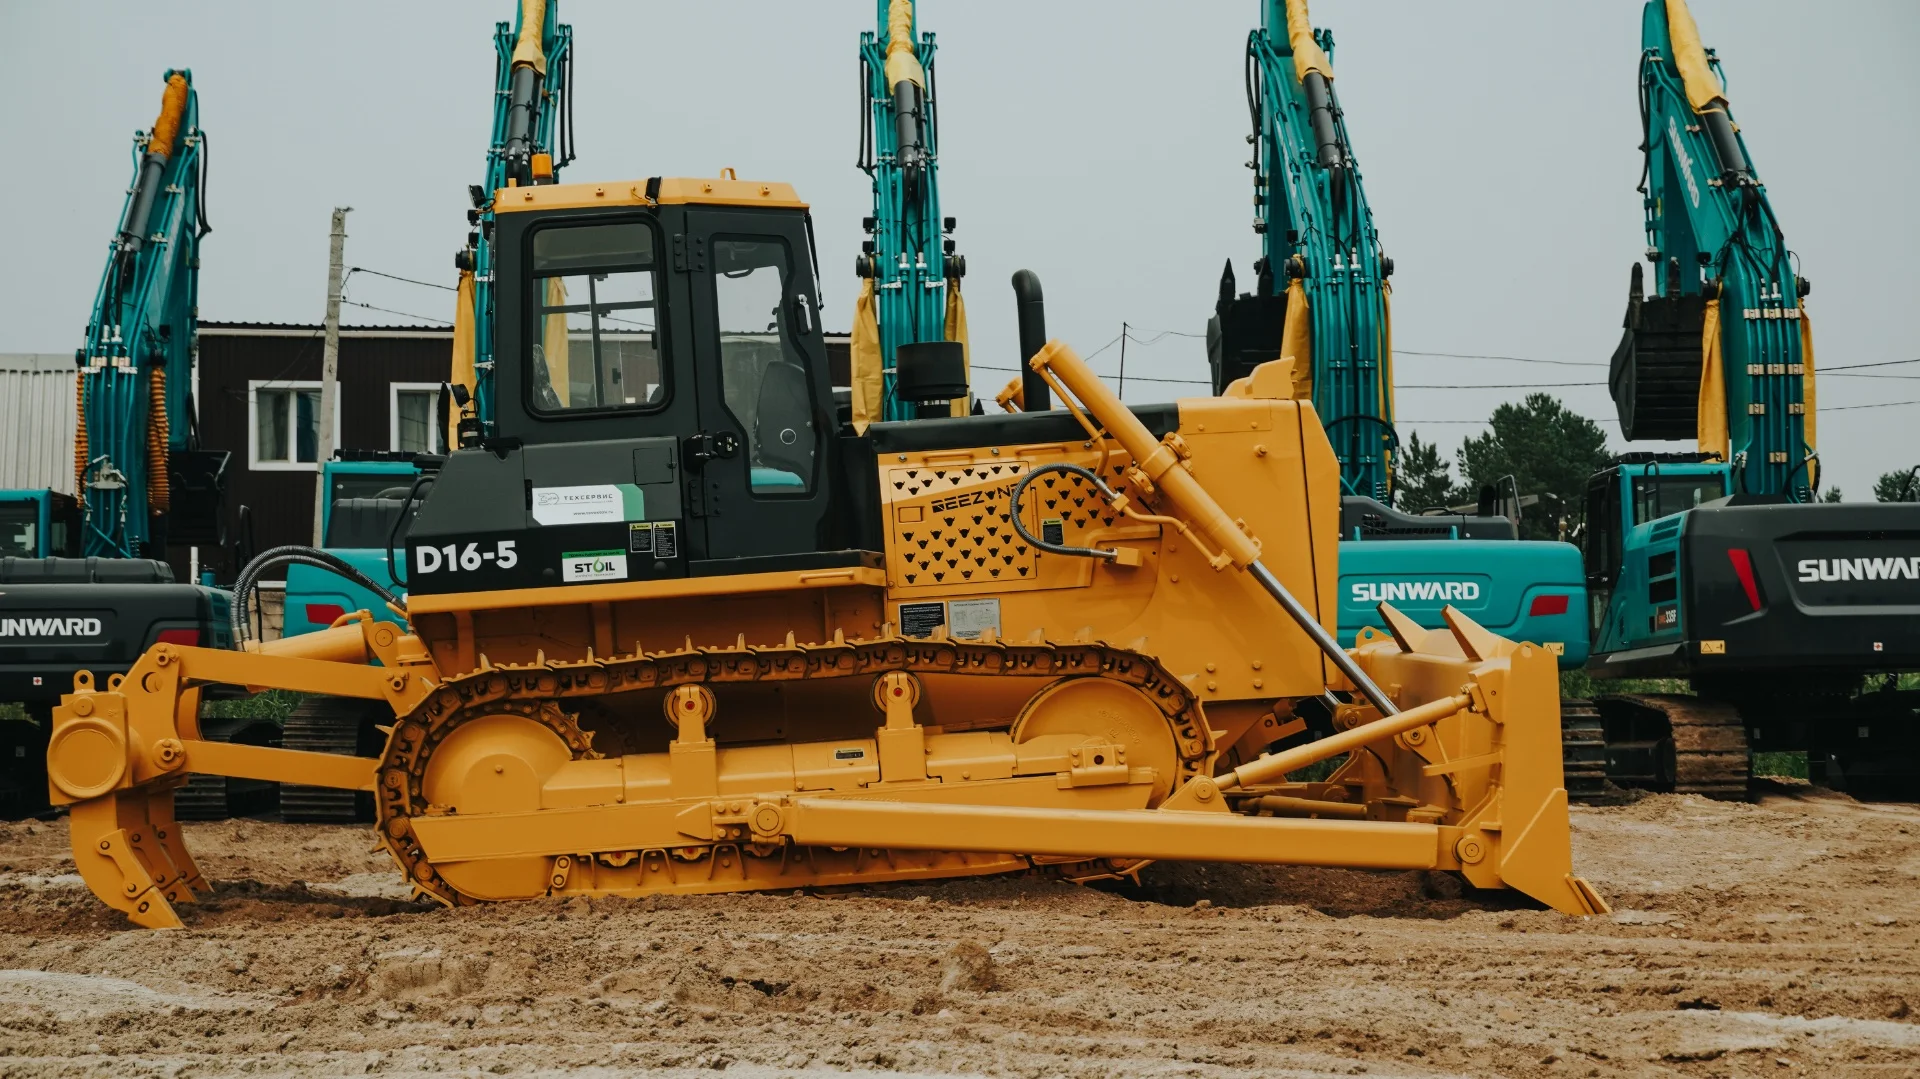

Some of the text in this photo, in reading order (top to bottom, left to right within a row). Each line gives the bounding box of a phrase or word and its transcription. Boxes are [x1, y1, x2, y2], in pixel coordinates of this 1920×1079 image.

[564, 493, 613, 501] ТЕХСЕРВИС
[416, 540, 518, 574] D16-5
[575, 558, 616, 573] STOIL
[1352, 581, 1480, 602] SUNWARD
